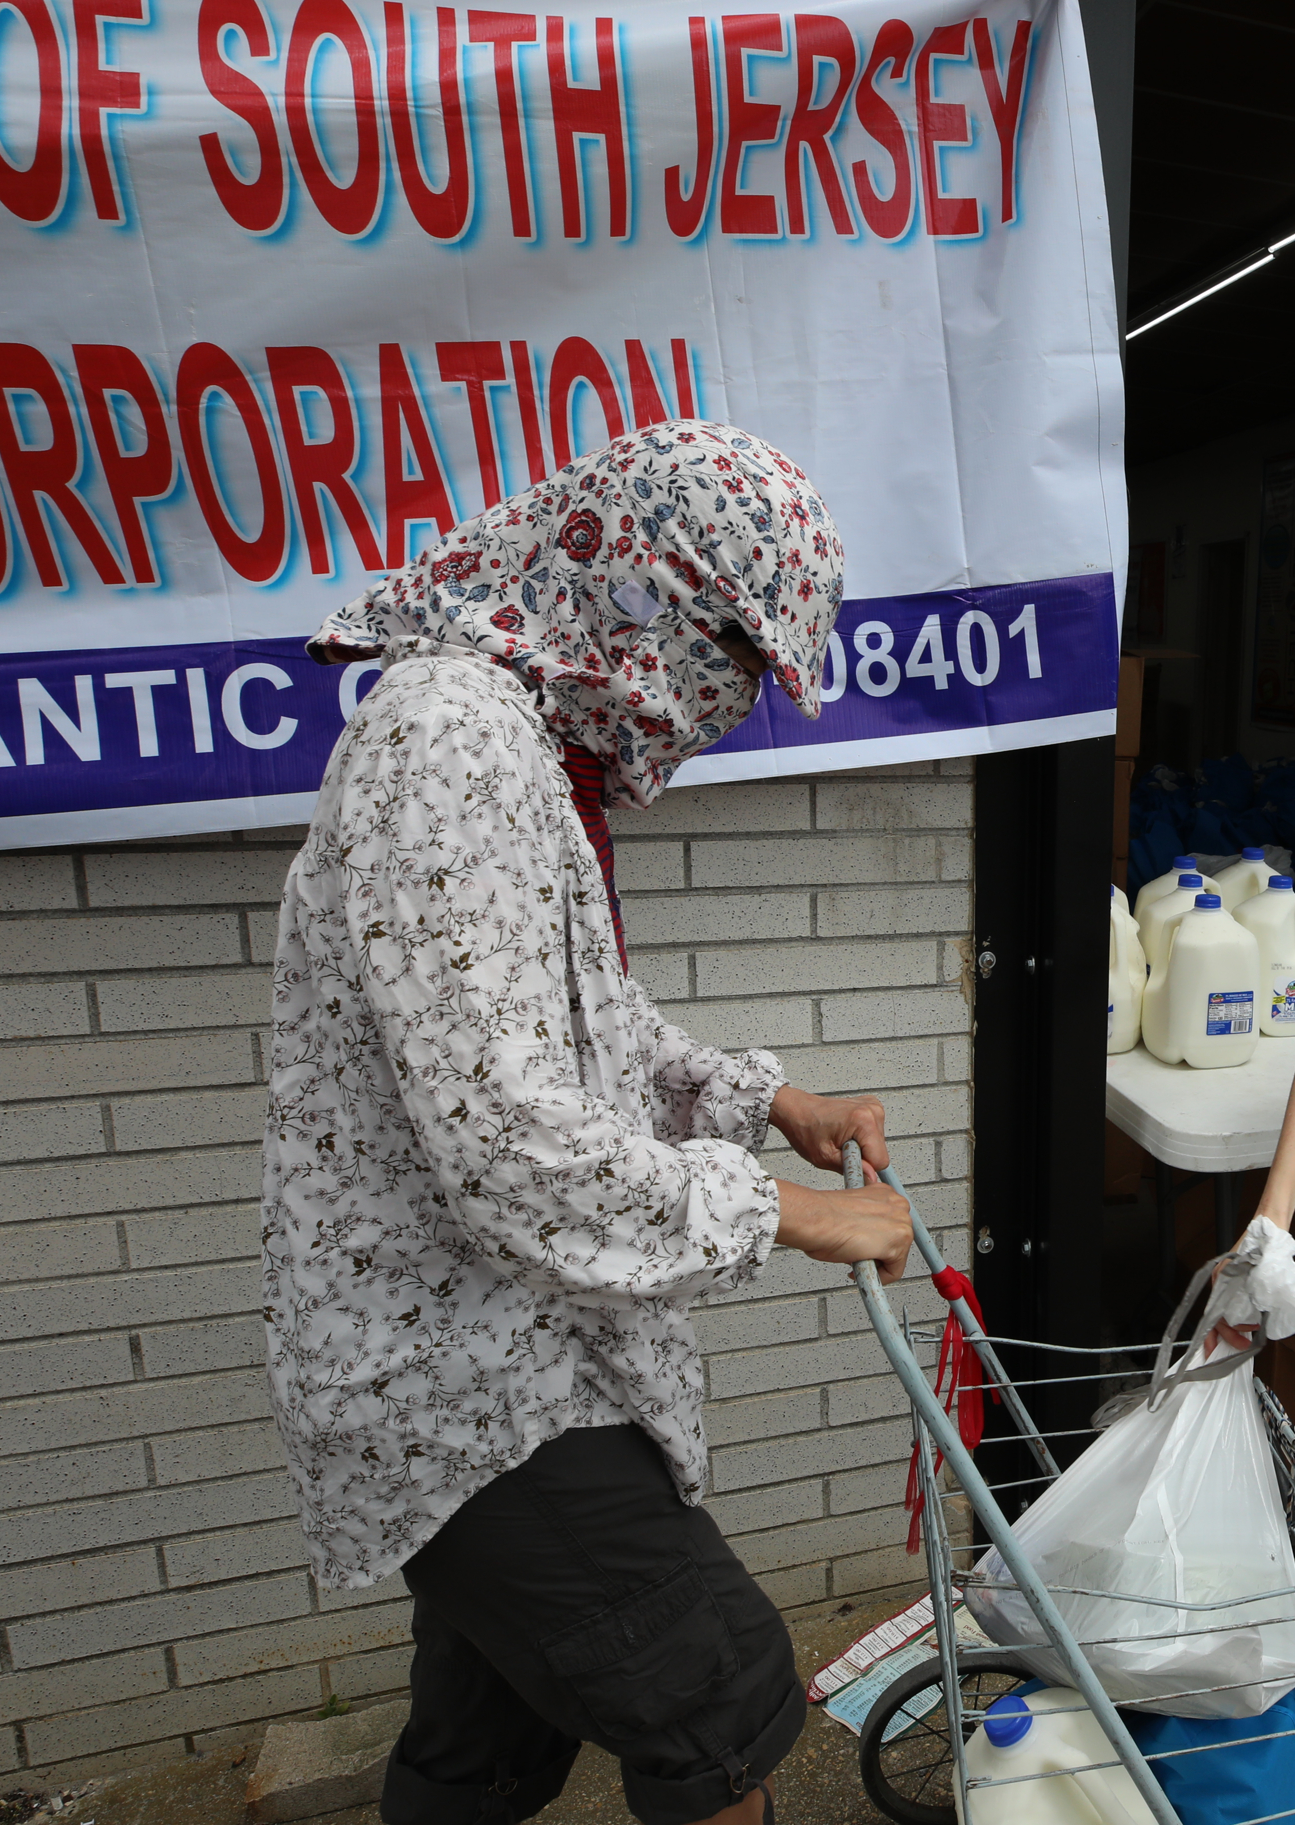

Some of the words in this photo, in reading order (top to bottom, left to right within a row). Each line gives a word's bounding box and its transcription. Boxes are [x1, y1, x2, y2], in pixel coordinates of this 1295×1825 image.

[0, 0, 144, 222] OF
[198, 0, 627, 239] SOUTH
[665, 14, 1031, 240] JERSEY
[0, 662, 299, 767] NTIC
[819, 604, 1043, 703] 08401
[962, 1624, 977, 1635] Food
